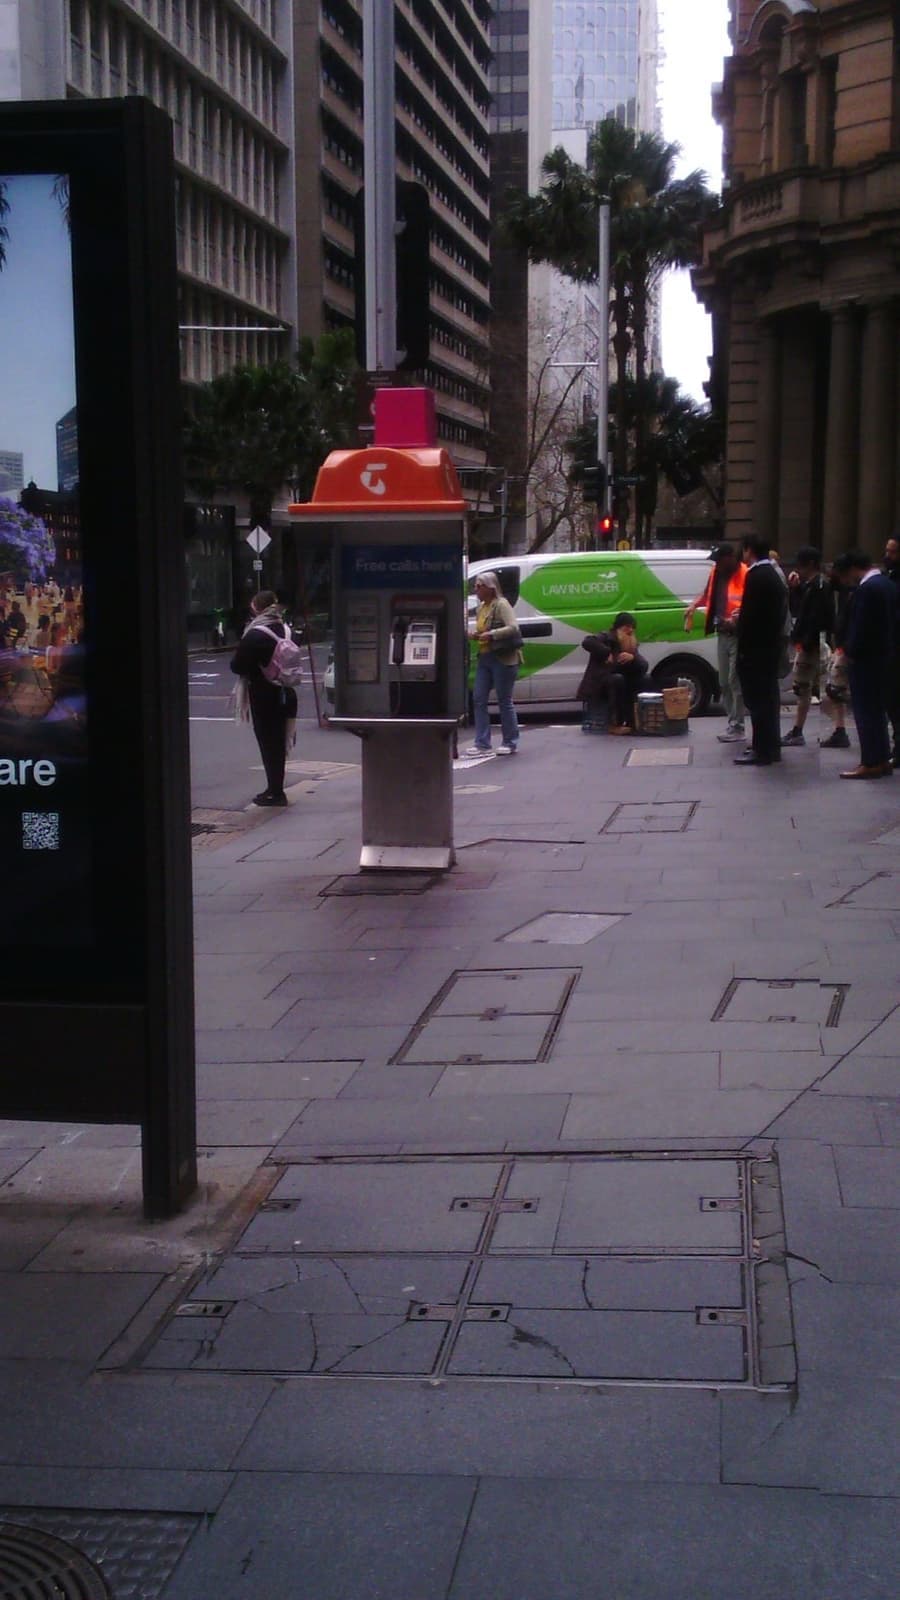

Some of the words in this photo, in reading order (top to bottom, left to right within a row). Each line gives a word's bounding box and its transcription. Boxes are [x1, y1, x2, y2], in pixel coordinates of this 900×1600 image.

[355, 558, 386, 572] Free
[389, 558, 419, 572] calls
[421, 558, 453, 572] here
[542, 583, 568, 596] LAW
[569, 583, 580, 594] IN
[581, 581, 619, 594] ORDER
